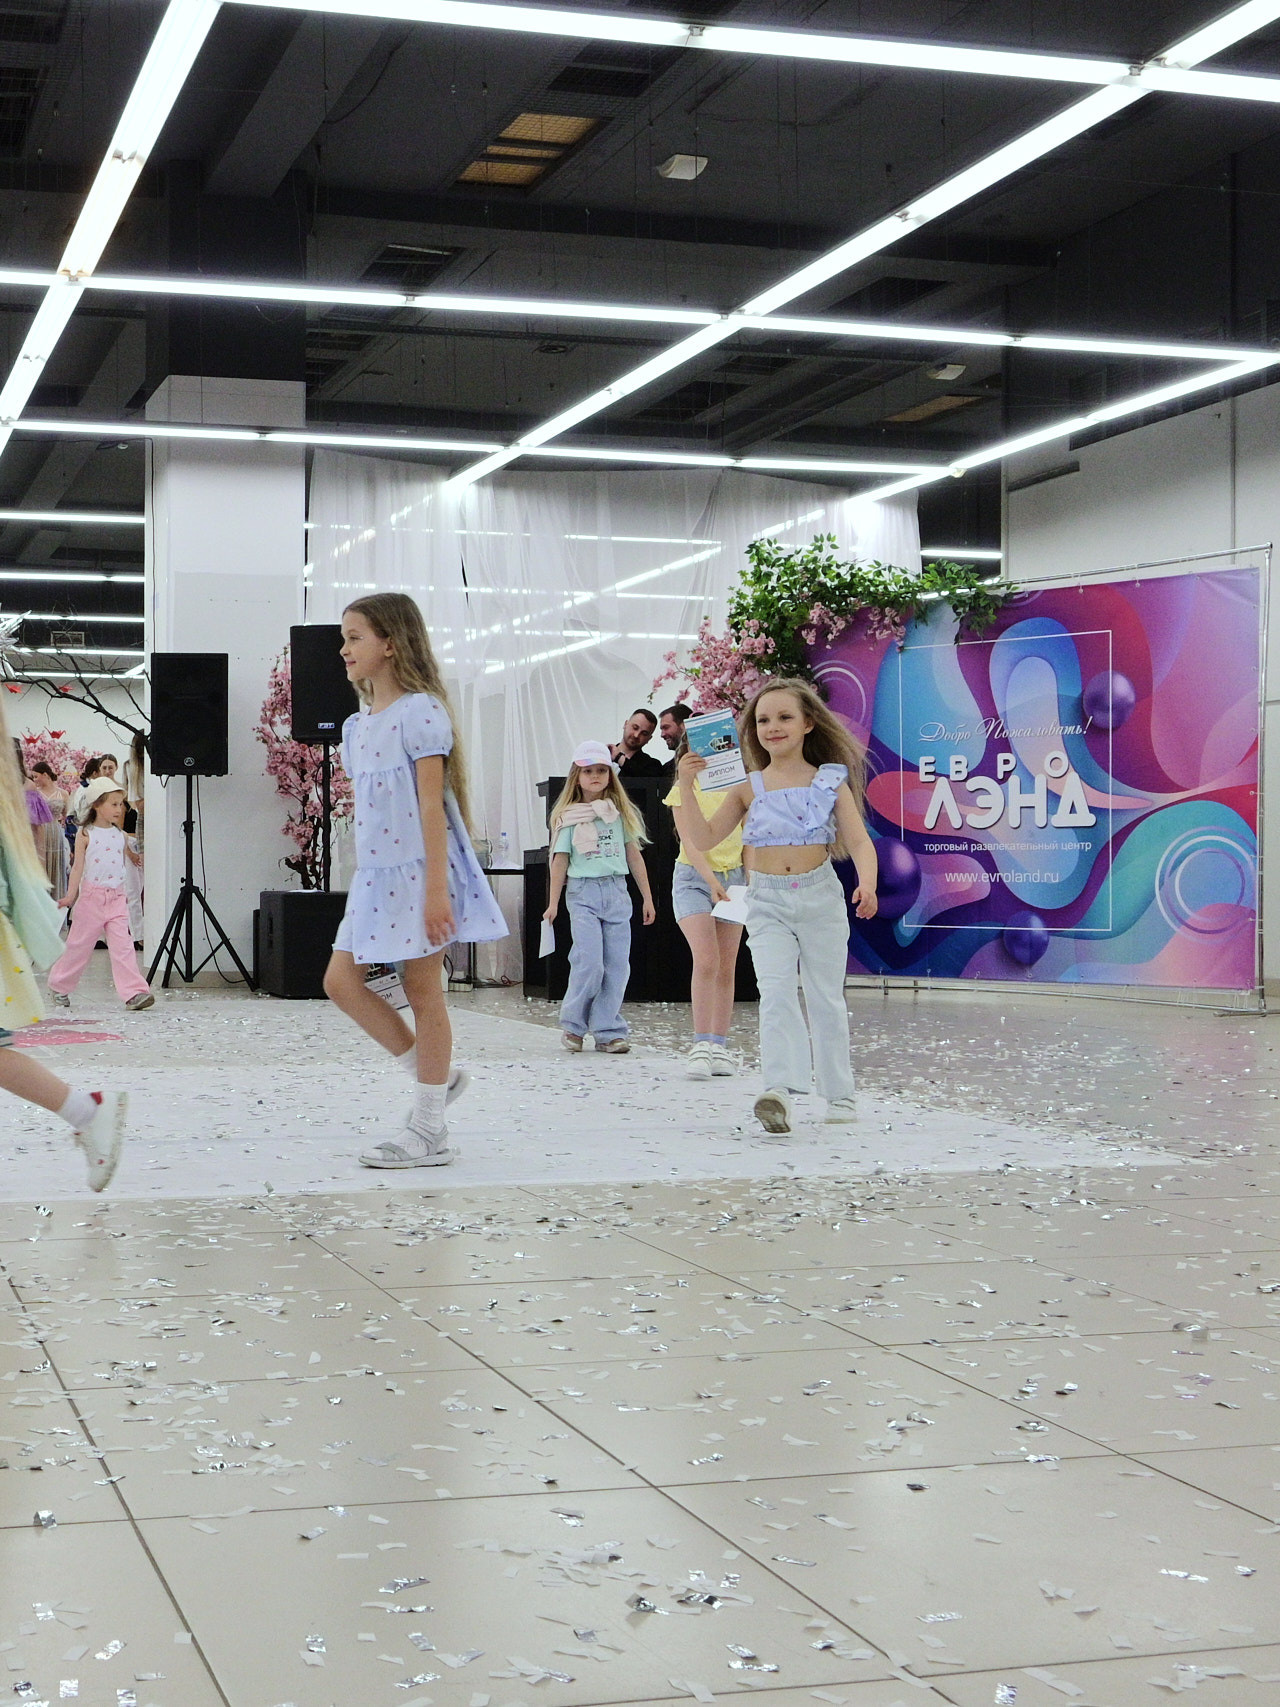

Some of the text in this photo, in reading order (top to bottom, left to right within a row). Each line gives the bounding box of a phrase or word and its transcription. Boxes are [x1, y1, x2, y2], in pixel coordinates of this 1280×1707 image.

[918, 716, 1093, 746] Добро Пожаловать!
[708, 765, 736, 779] ДИПЛОМ
[923, 771, 1097, 830] ЛЭНД
[924, 841, 1092, 853] торговый развлекательный центр
[944, 869, 1059, 884] www.evroland.ru
